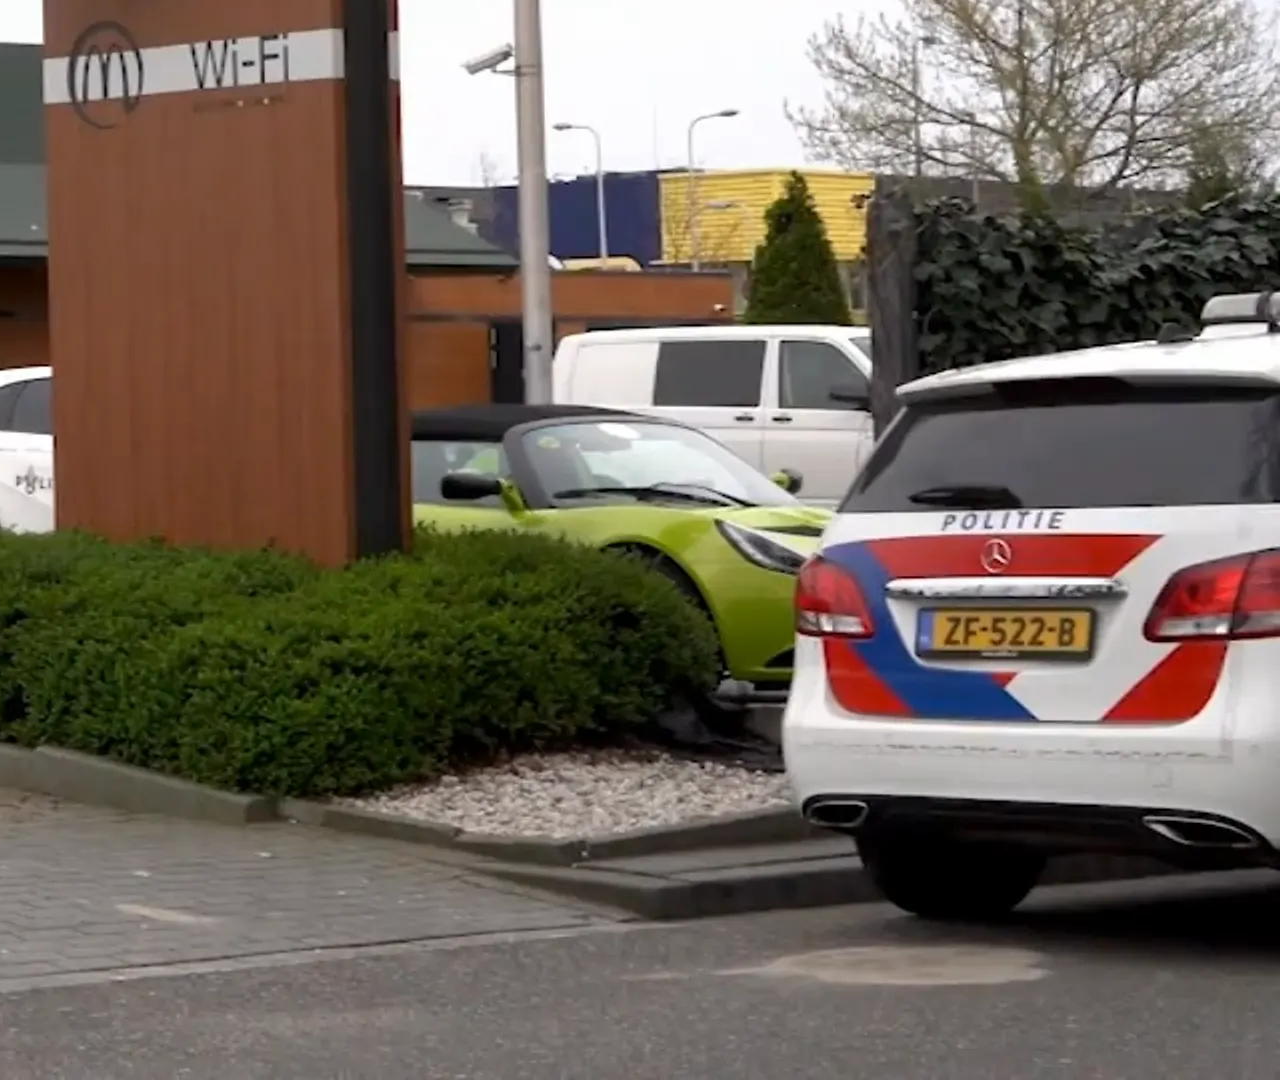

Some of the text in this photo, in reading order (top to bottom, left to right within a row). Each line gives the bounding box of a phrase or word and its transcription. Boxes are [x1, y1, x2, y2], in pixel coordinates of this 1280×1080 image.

[190, 32, 289, 89] Wi-Fi
[941, 511, 1064, 531] POLITIE
[944, 616, 1076, 647] ZF-522-B
